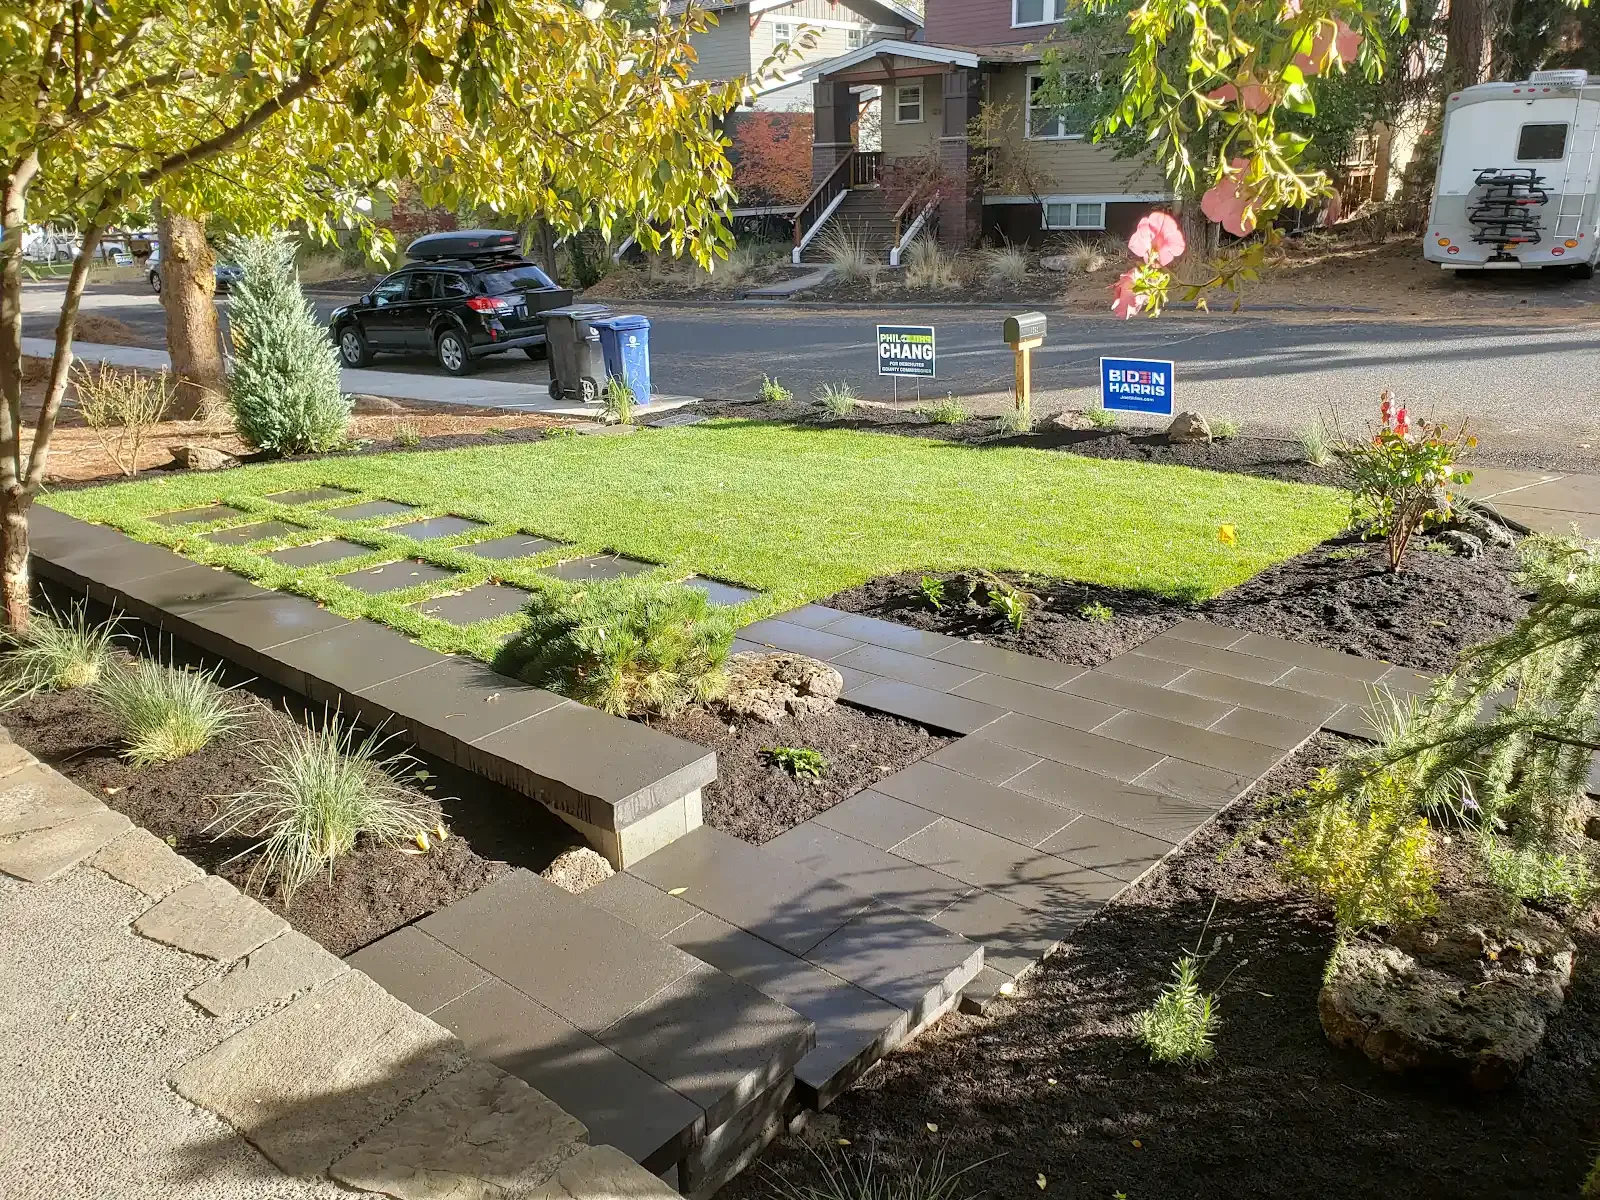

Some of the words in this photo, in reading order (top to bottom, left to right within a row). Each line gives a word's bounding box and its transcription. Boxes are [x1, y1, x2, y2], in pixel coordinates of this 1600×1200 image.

[880, 334, 901, 342] PHIL
[880, 343, 932, 360] CHANG
[1109, 369, 1165, 385] BIDEN
[1110, 382, 1165, 397] HARRIS
